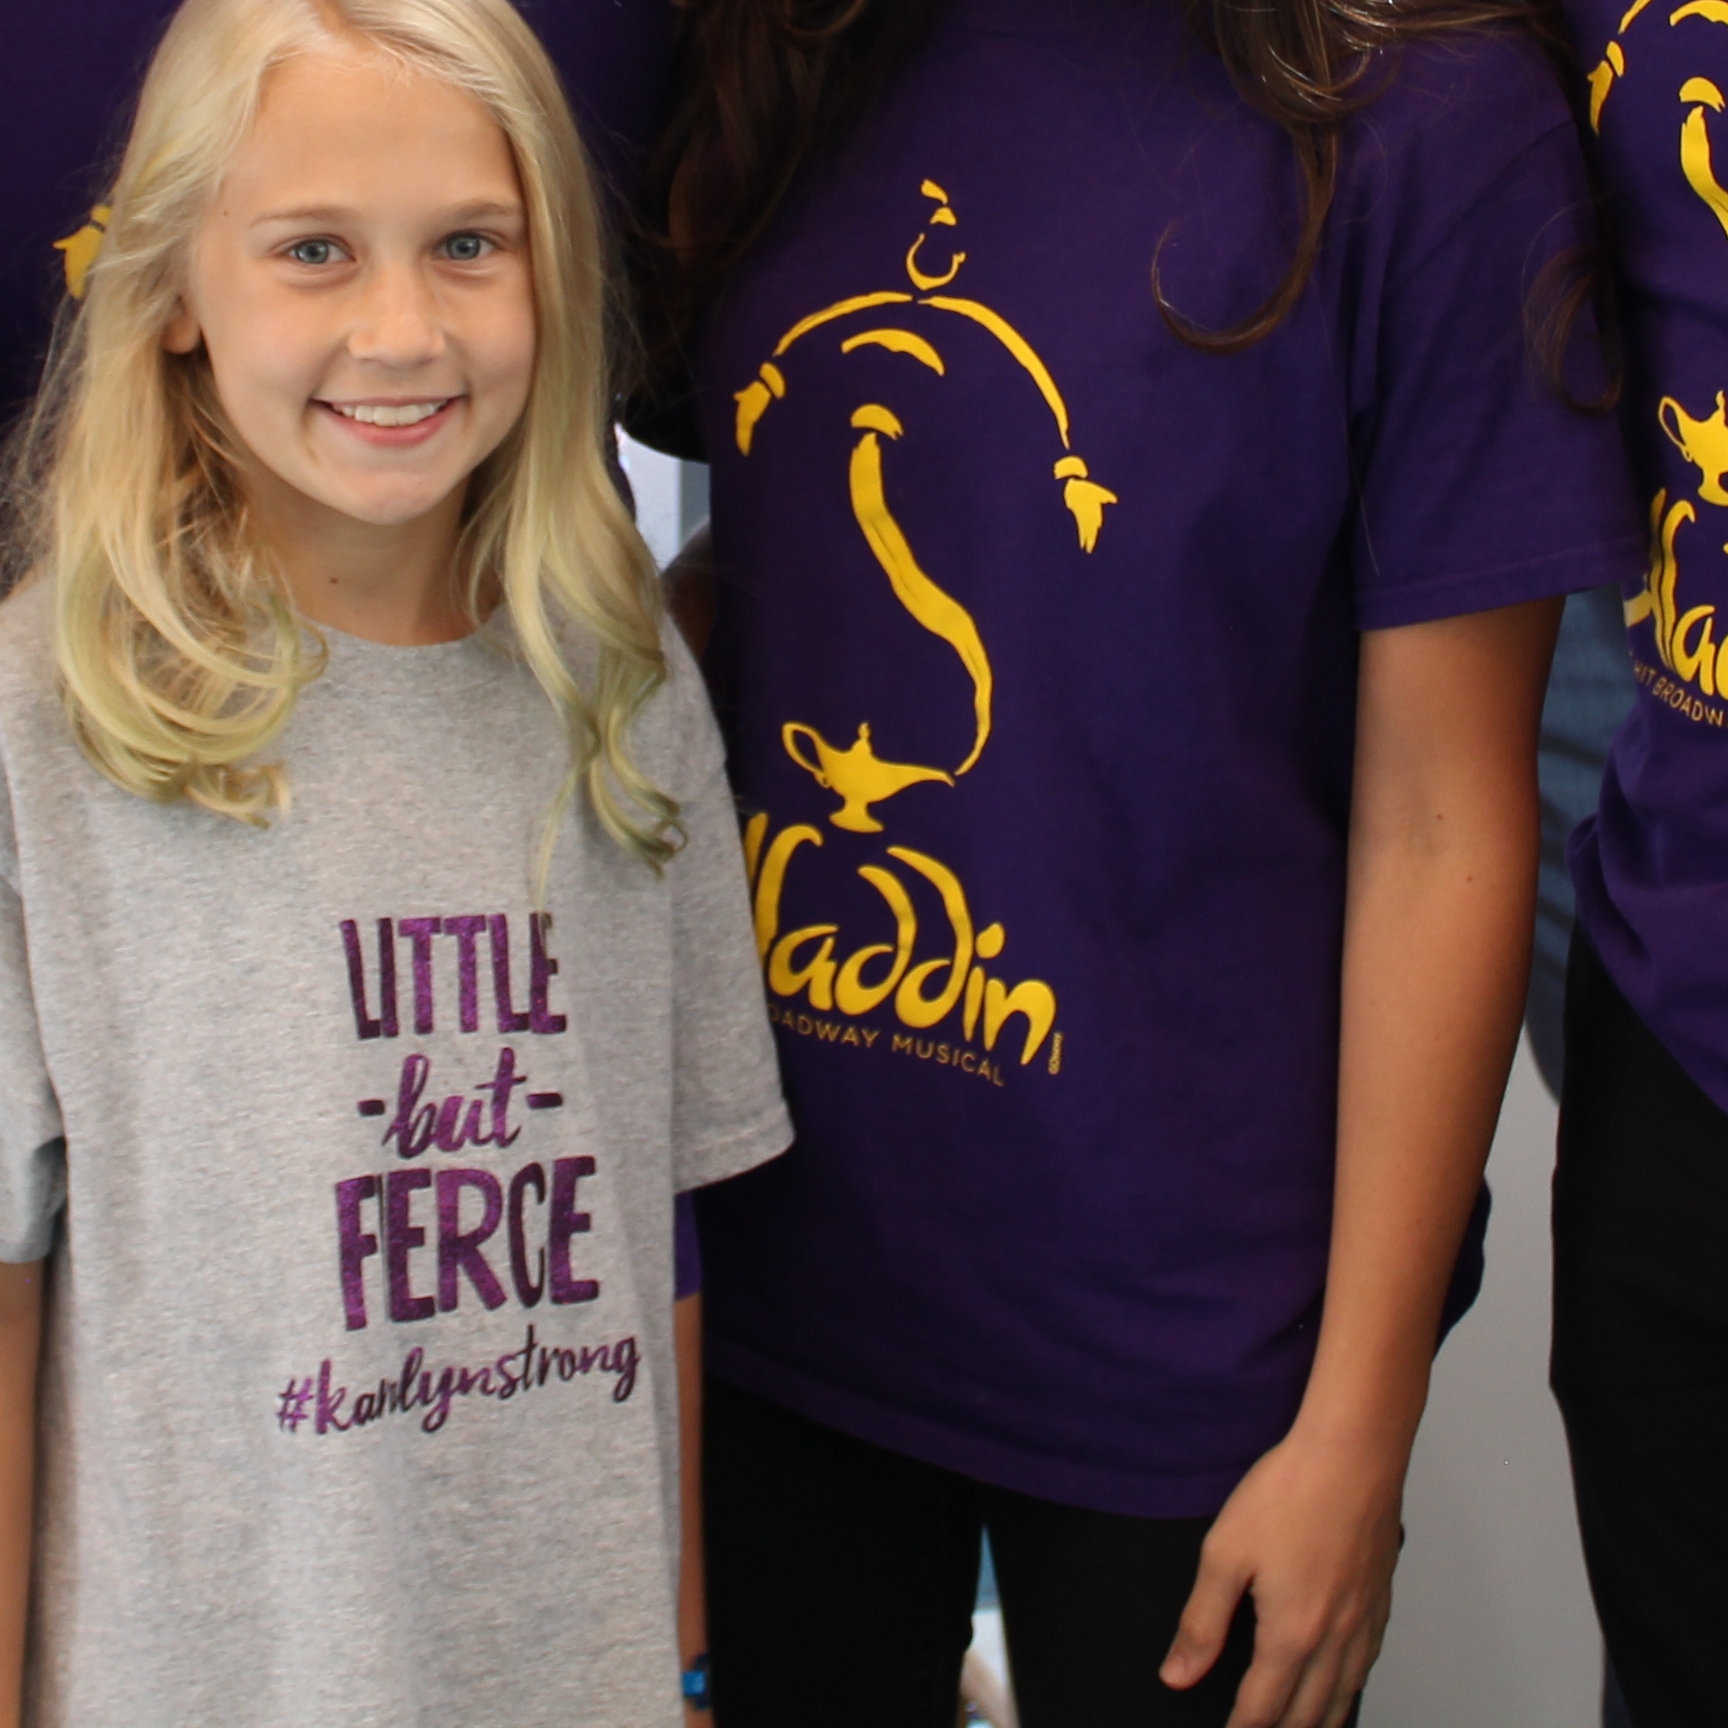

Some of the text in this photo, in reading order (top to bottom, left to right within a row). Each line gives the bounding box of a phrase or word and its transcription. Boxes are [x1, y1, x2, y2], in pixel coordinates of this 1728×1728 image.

[339, 912, 567, 1040] LITTLE
[745, 812, 1057, 1066] laddin
[891, 1032, 1005, 1088] MUSICAL
[334, 1155, 600, 1331] FERCE
